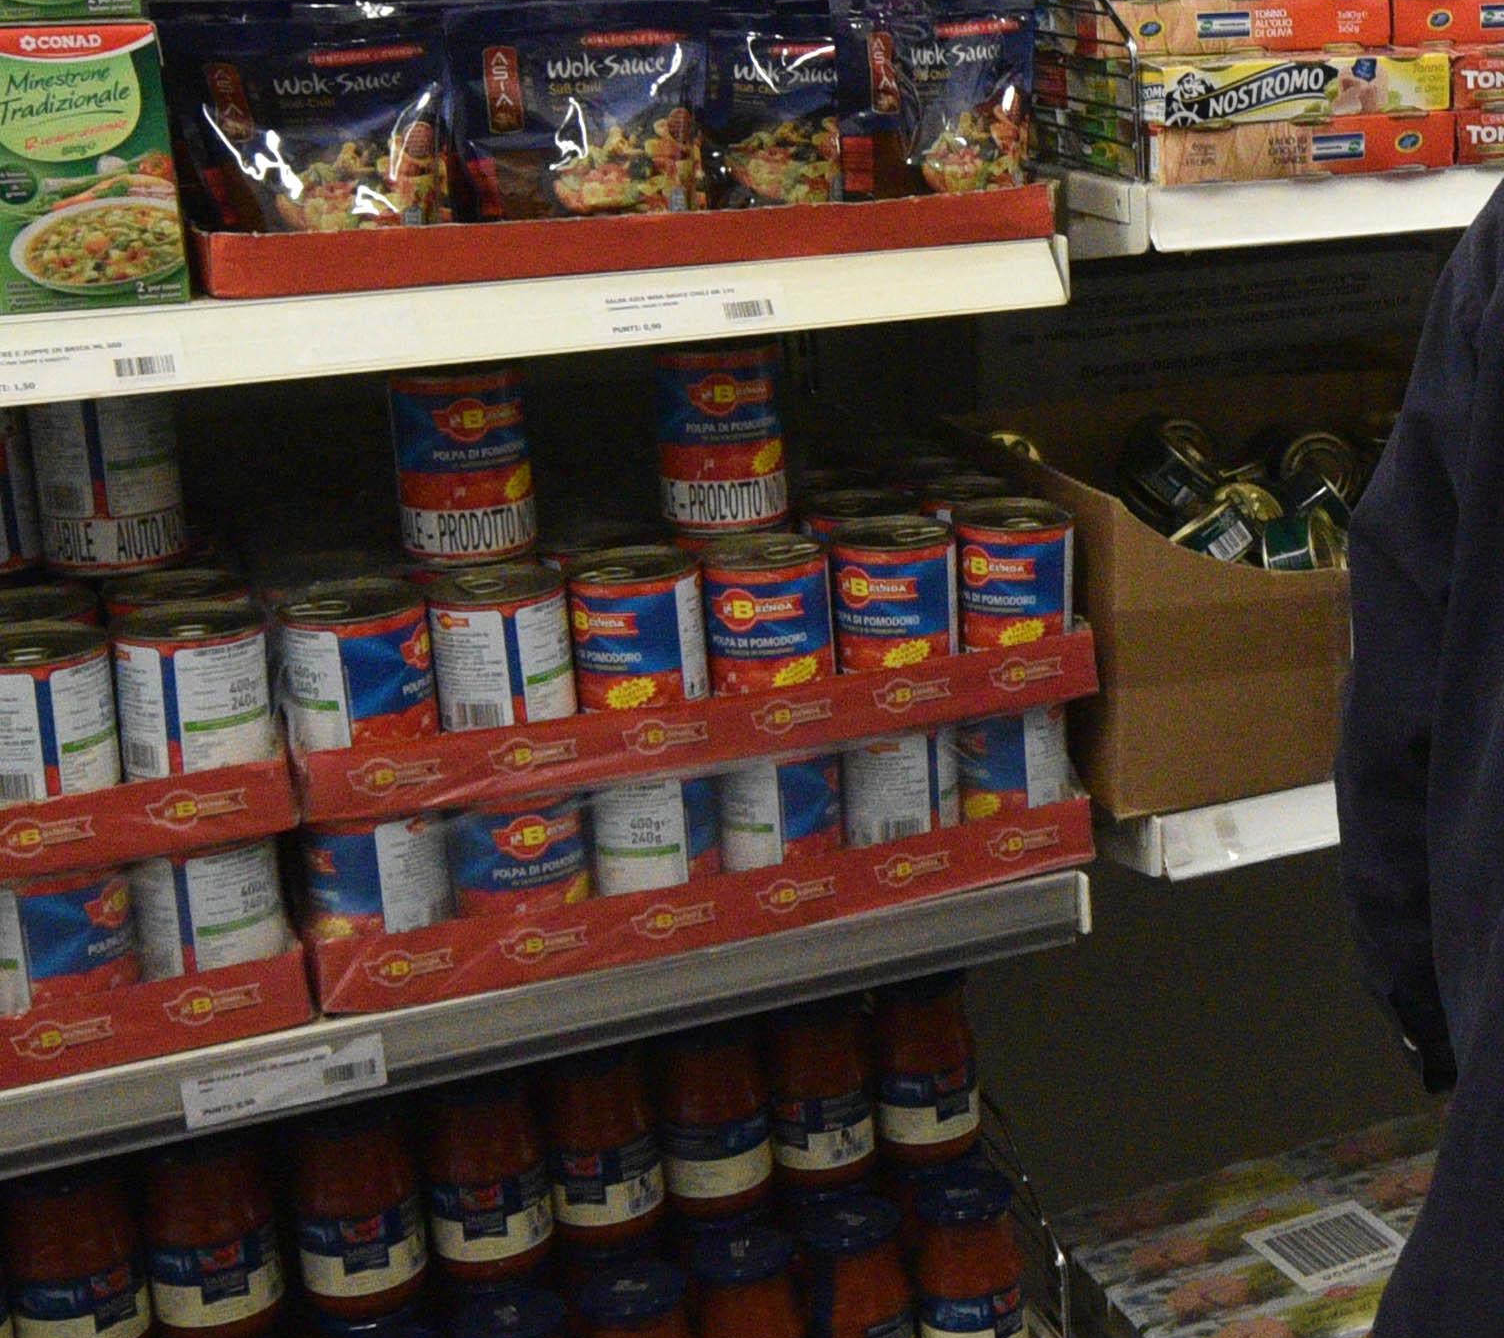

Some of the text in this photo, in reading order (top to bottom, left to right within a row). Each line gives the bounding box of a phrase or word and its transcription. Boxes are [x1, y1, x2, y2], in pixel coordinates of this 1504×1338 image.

[36, 34, 102, 49] CONAD
[1256, 28, 1293, 37] DI OLIVA
[546, 52, 667, 81] Wok-Sauce
[5, 65, 110, 98] Minestrone
[273, 70, 401, 97] Wok-Sauce
[1208, 68, 1324, 117] NOSTROMO
[688, 481, 762, 521] PRODOTTO
[438, 507, 514, 552] PRODOTTO
[982, 594, 1035, 606] POMODORO
[863, 614, 919, 626] POMODORO
[749, 632, 807, 648] POMODORO
